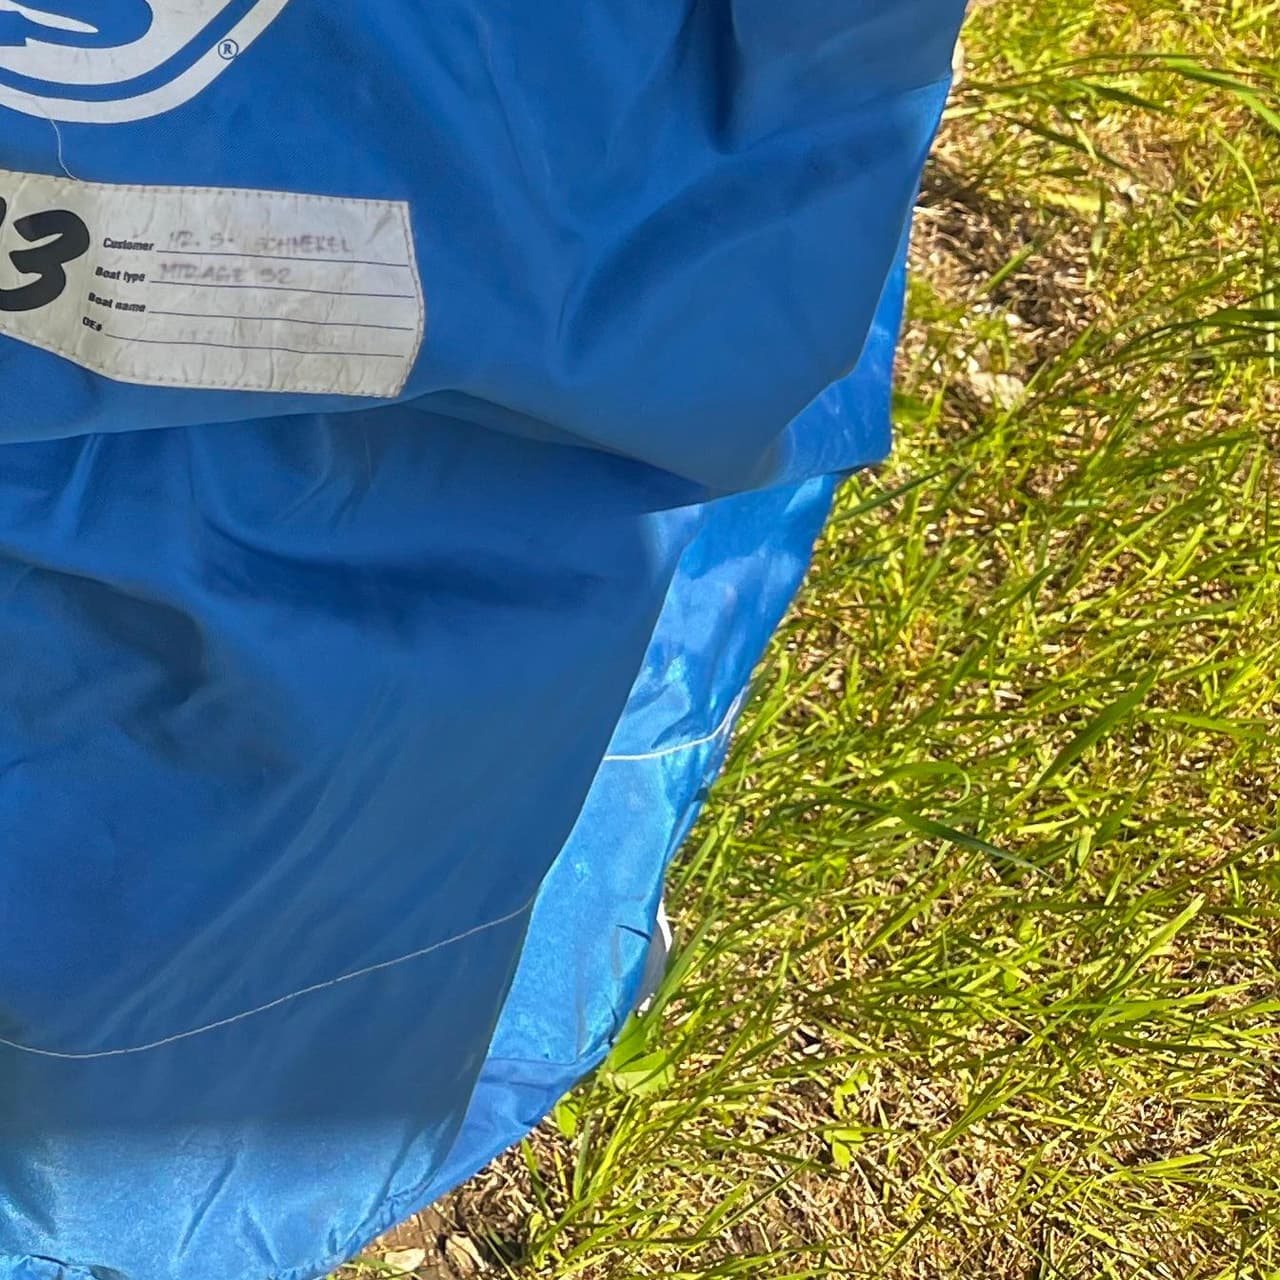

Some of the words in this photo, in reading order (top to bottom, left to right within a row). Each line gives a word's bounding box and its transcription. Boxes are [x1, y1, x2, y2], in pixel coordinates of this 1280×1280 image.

[102, 236, 155, 252] Customer
[95, 266, 120, 280] Boat
[122, 269, 145, 283] type
[88, 291, 113, 309] Boat
[115, 300, 146, 313] name
